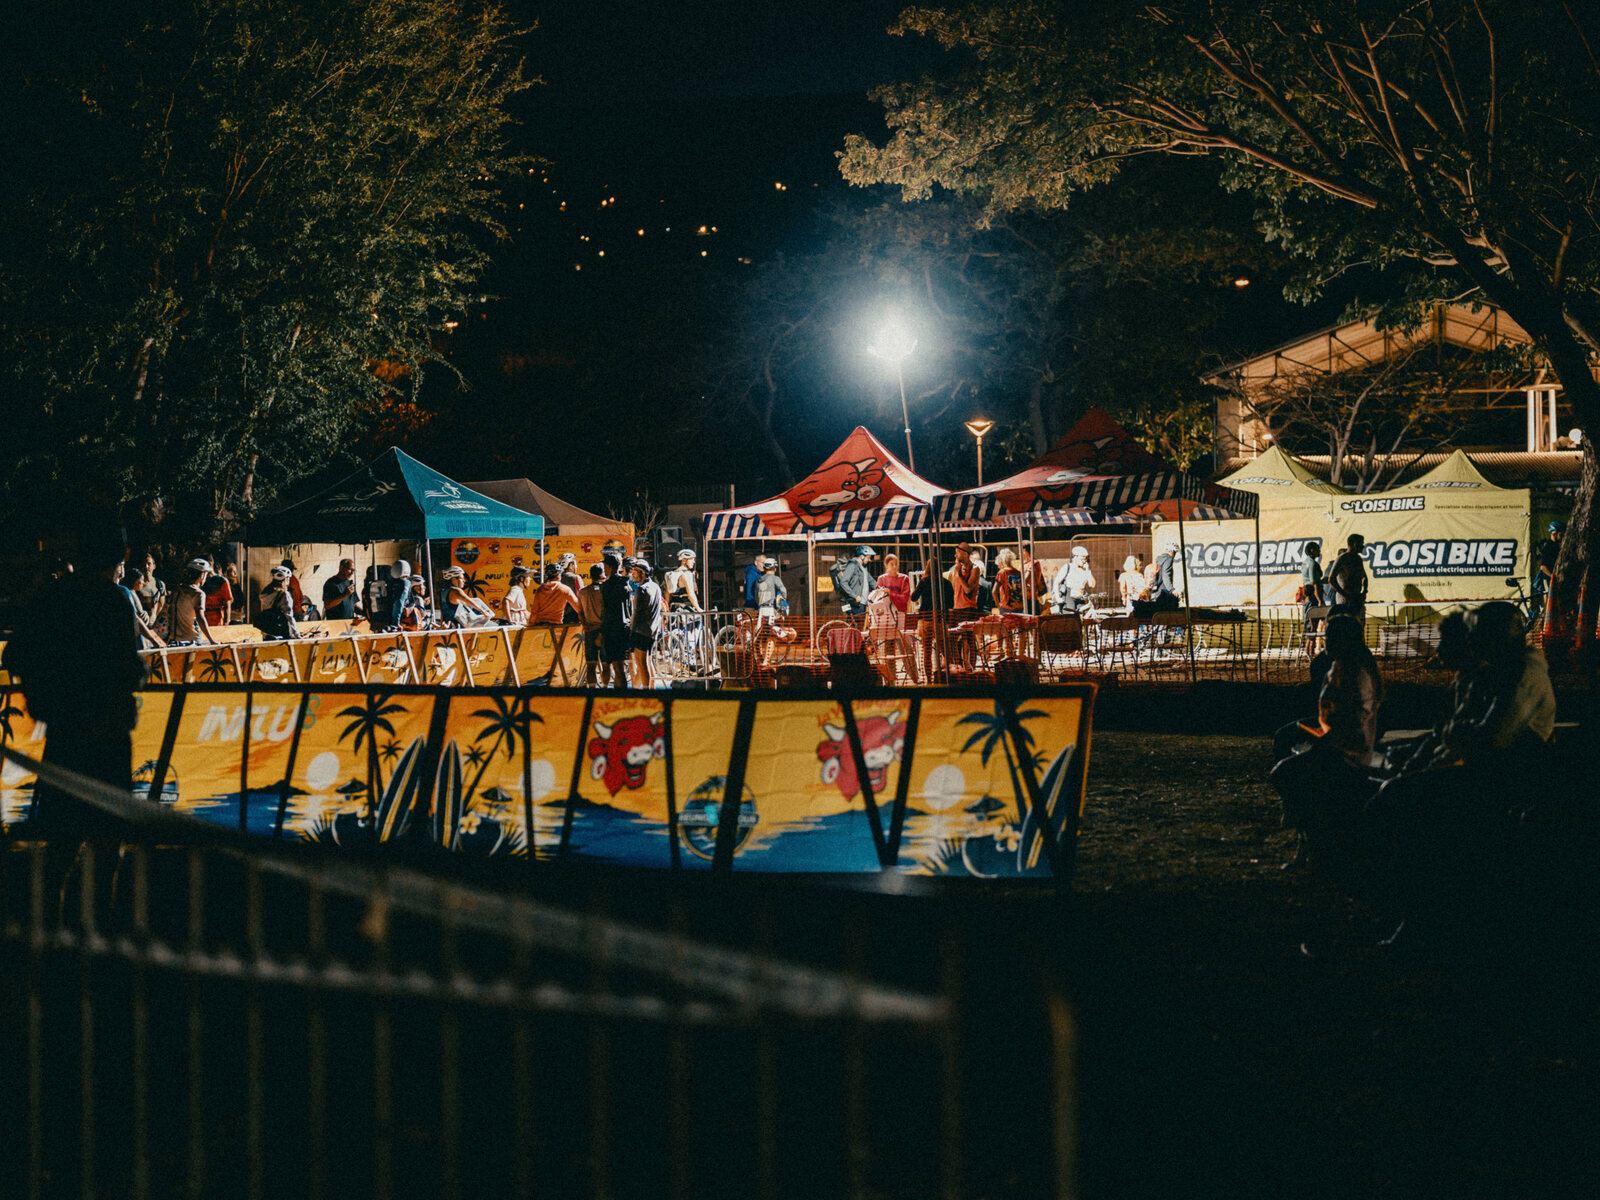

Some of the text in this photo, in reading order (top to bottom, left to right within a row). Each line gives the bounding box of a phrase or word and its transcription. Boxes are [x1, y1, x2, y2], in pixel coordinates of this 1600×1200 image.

[1419, 481, 1481, 489] LOISI BIKE
[1353, 497, 1425, 513] LOISI BIKE
[1190, 543, 1257, 568] LOISI
[1371, 541, 1515, 568] LOISI BIKE
[1193, 566, 1229, 575] Spécialiste
[1229, 566, 1247, 574] vélos
[1286, 564, 1294, 572] et
[1376, 566, 1415, 576] Spécialiste
[1415, 566, 1435, 574] vélos
[1436, 565, 1477, 574] électriques
[1487, 565, 1511, 573] loisirs
